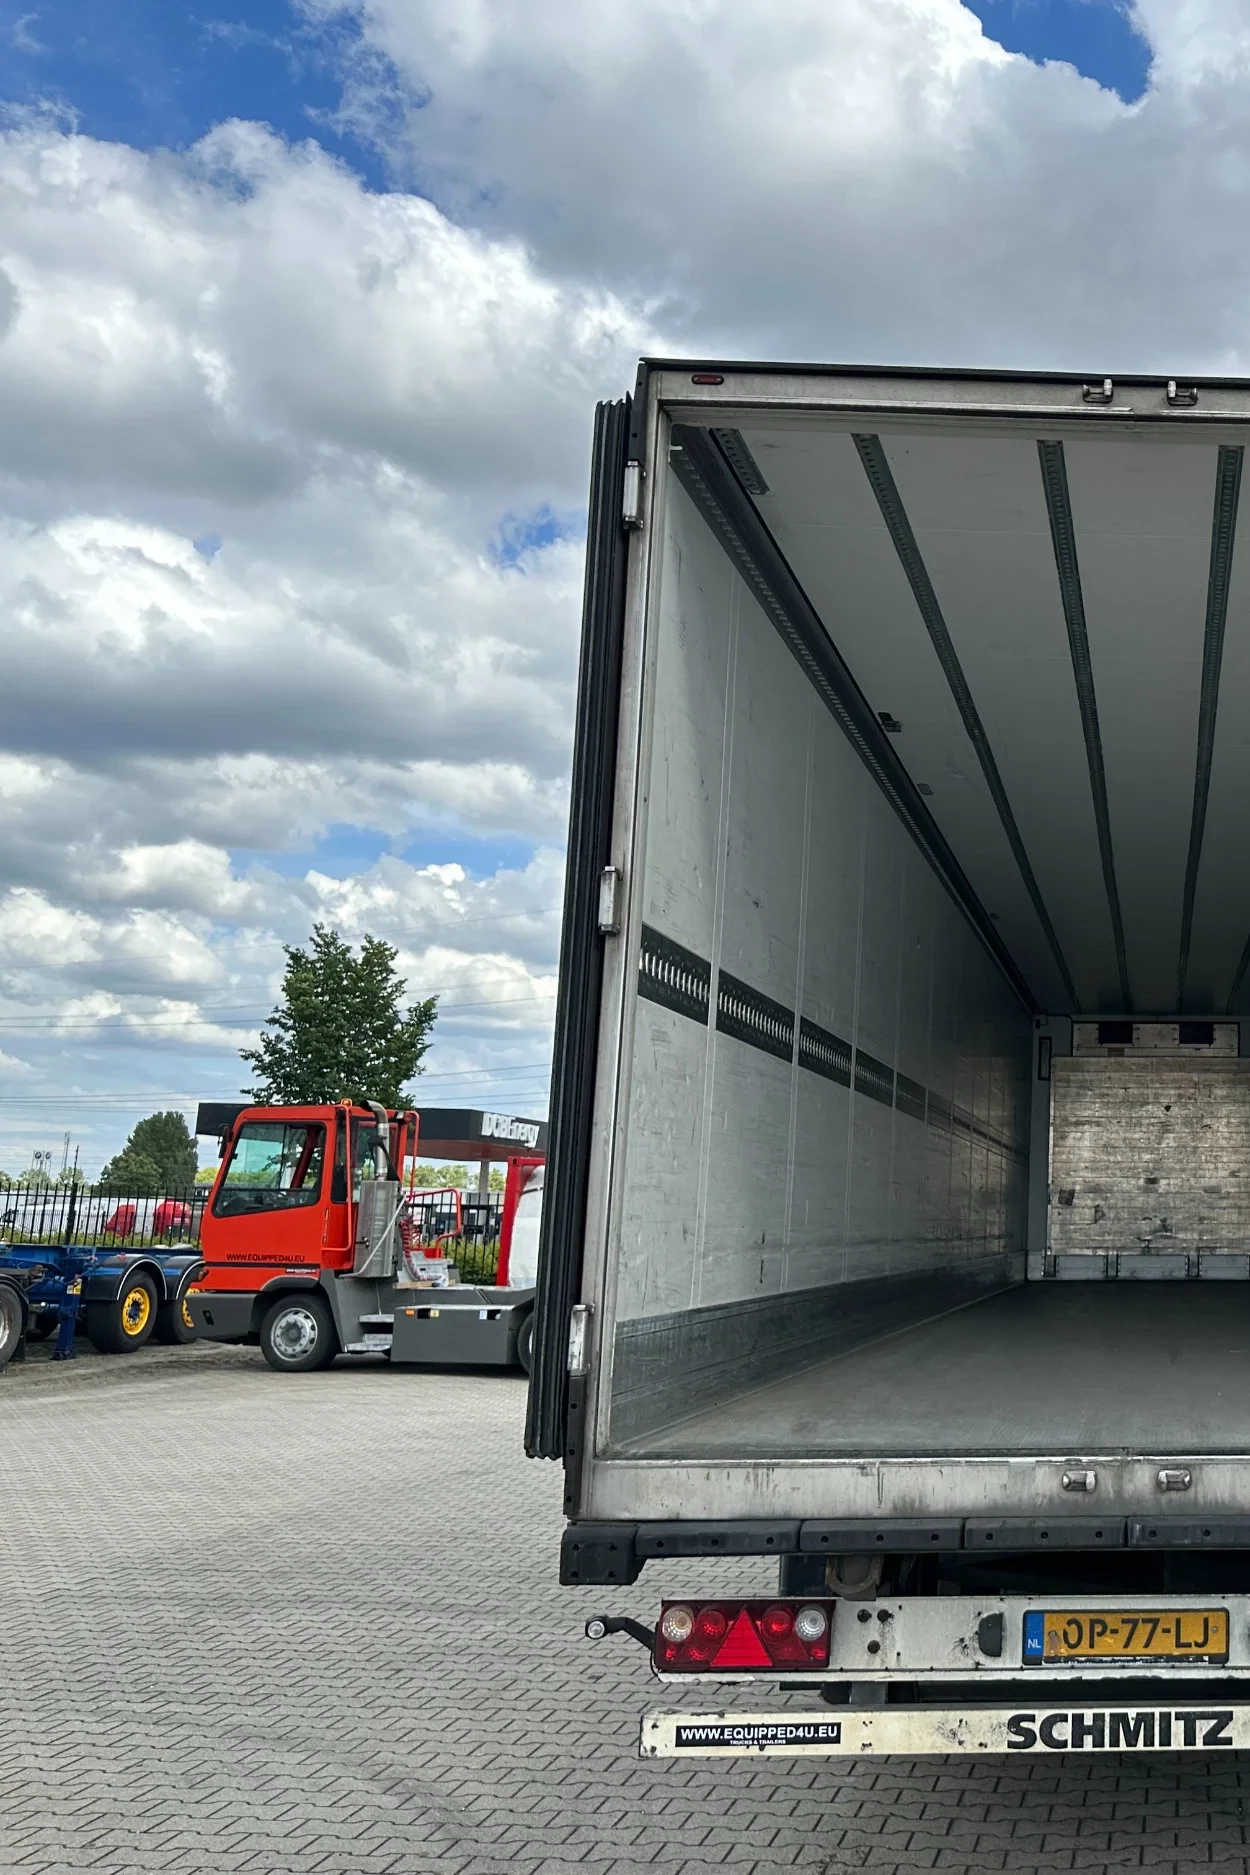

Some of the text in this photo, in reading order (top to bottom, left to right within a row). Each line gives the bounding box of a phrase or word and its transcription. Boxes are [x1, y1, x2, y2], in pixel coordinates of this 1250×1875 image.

[1027, 1638, 1042, 1649] NL
[1062, 1617, 1209, 1649] OP-77-LJ
[680, 1725, 838, 1740] WWW.EQUIPPED4U.EU
[1007, 1710, 1234, 1750] SCHMITZ
